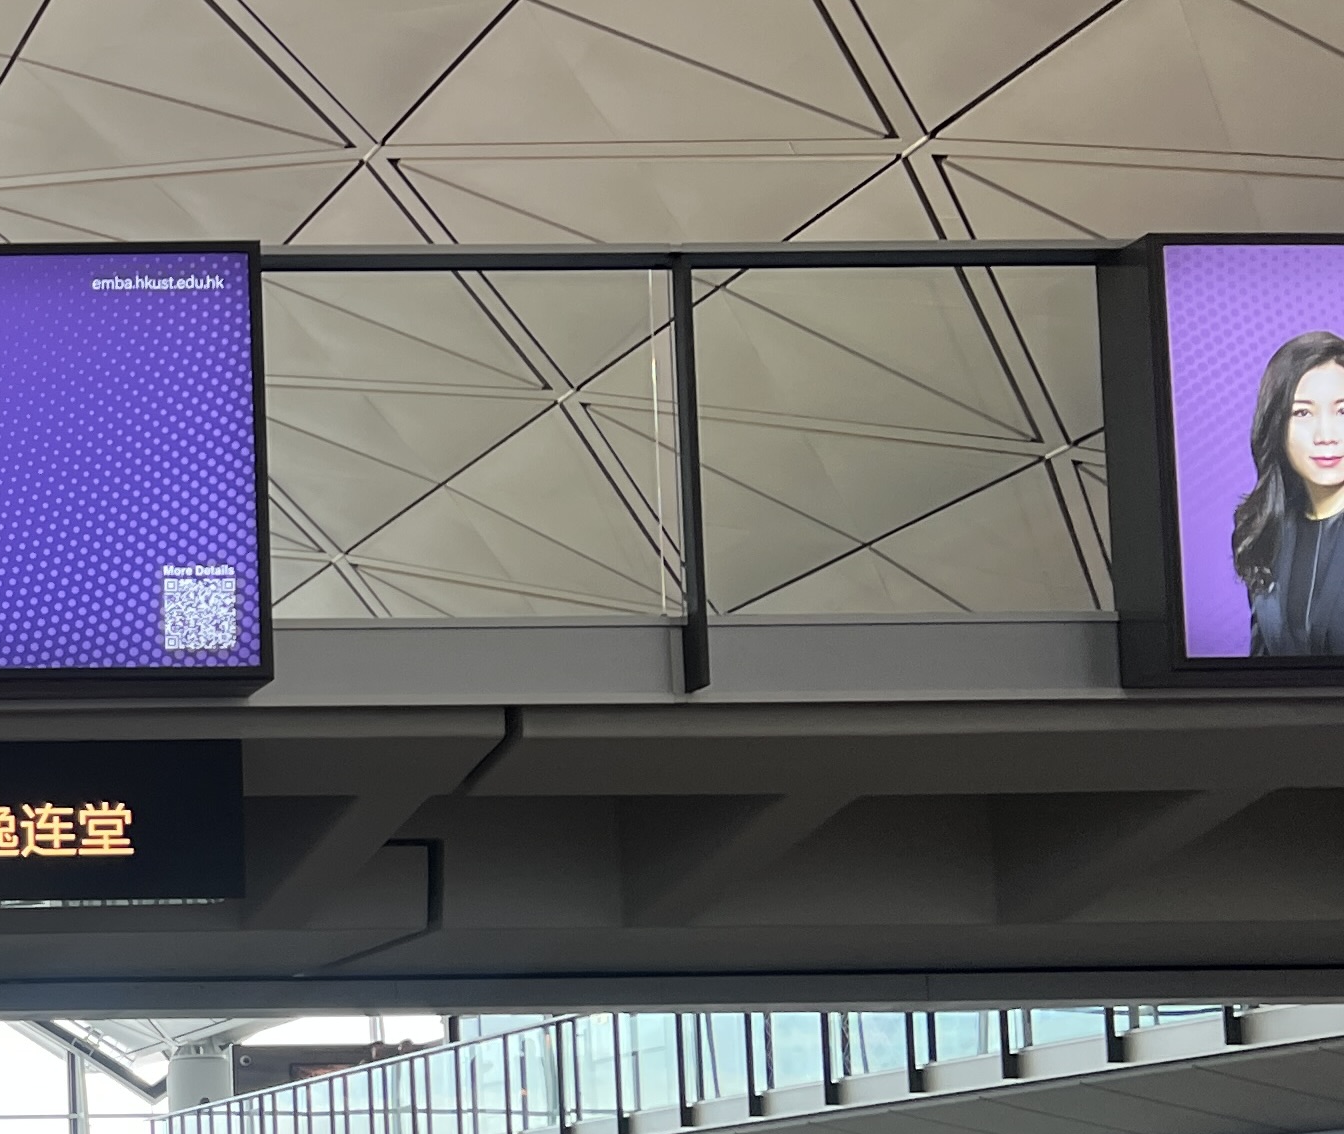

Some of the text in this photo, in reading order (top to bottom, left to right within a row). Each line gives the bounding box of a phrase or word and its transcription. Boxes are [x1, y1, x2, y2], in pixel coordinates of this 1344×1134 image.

[92, 274, 225, 290] emba.hkust.edu.hk
[163, 564, 236, 576] More Details
